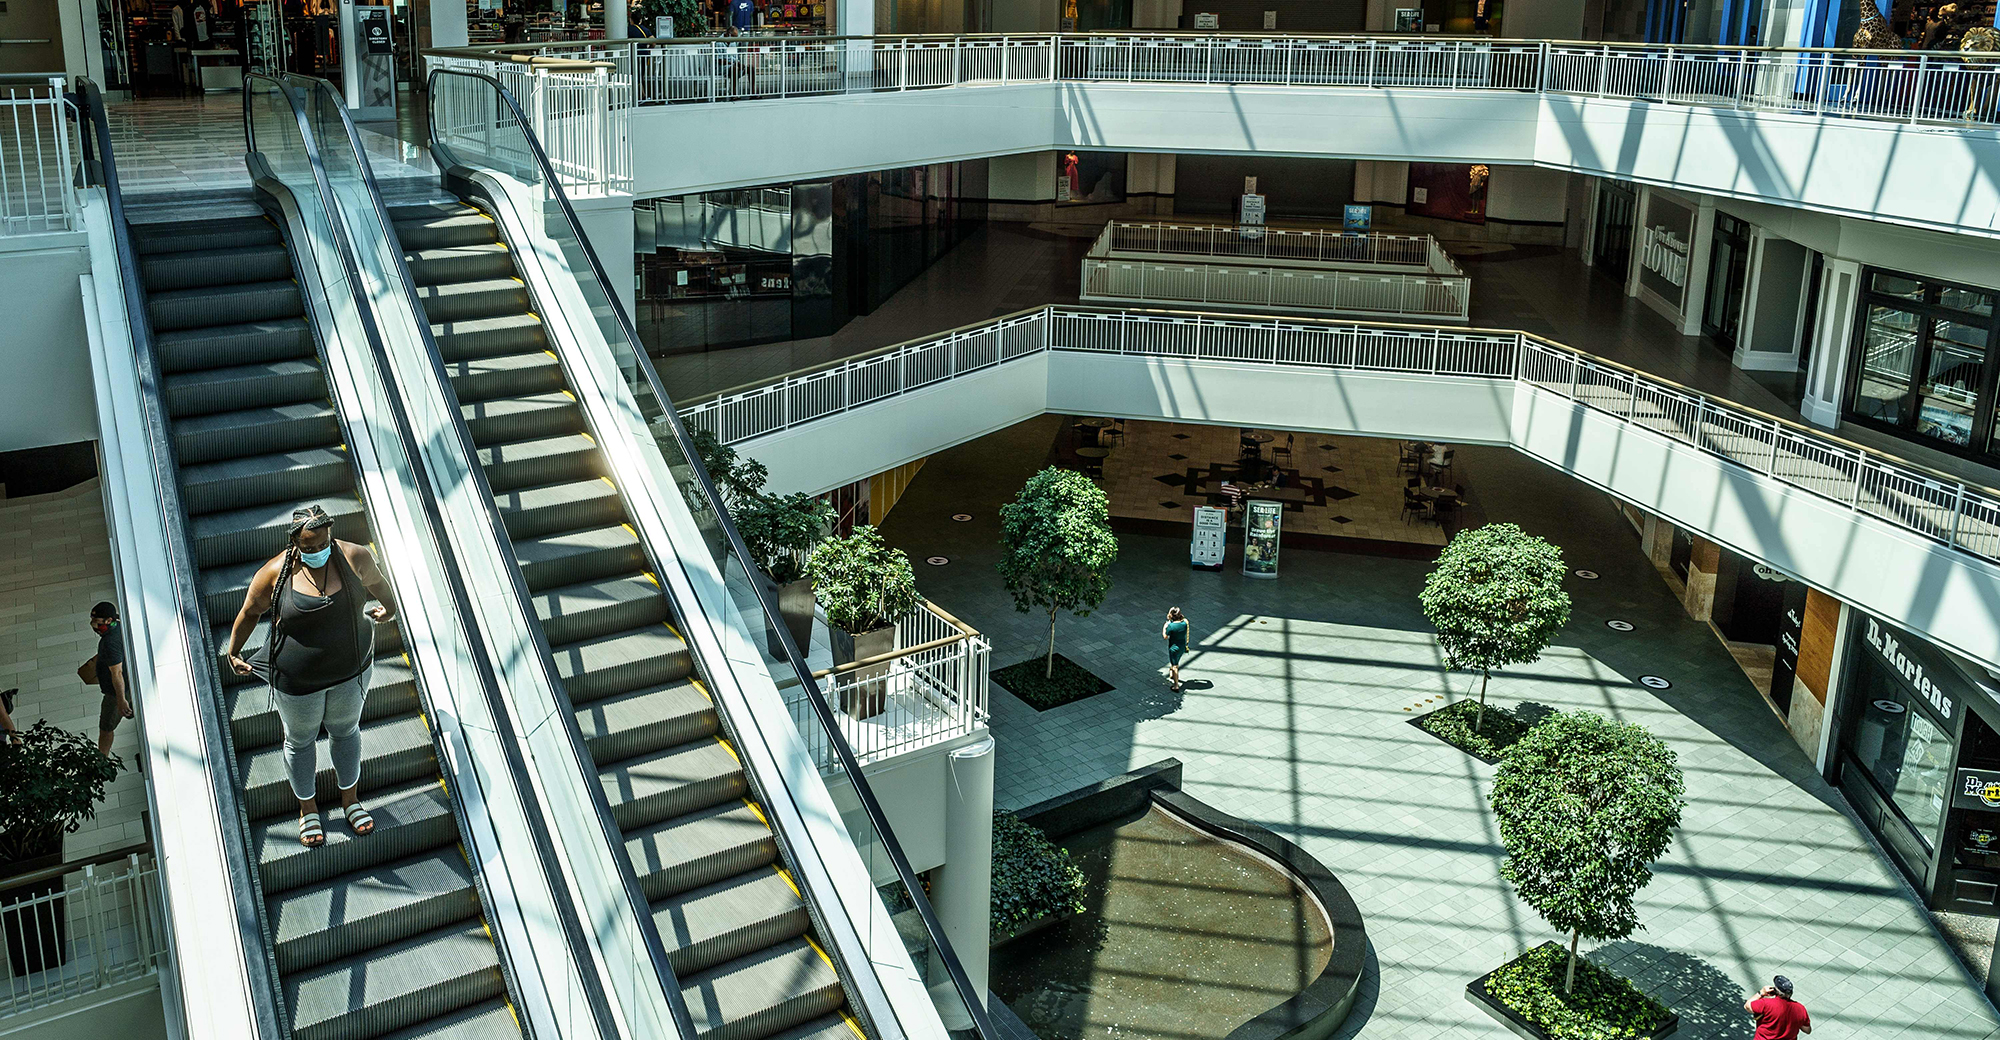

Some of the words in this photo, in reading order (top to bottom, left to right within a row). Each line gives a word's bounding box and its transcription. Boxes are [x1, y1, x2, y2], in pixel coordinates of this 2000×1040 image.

[1640, 226, 1687, 287] HOME
[1882, 632, 1952, 719] Martens
[1911, 714, 1932, 742] TOUGH
[1964, 784, 2000, 798] Mart
